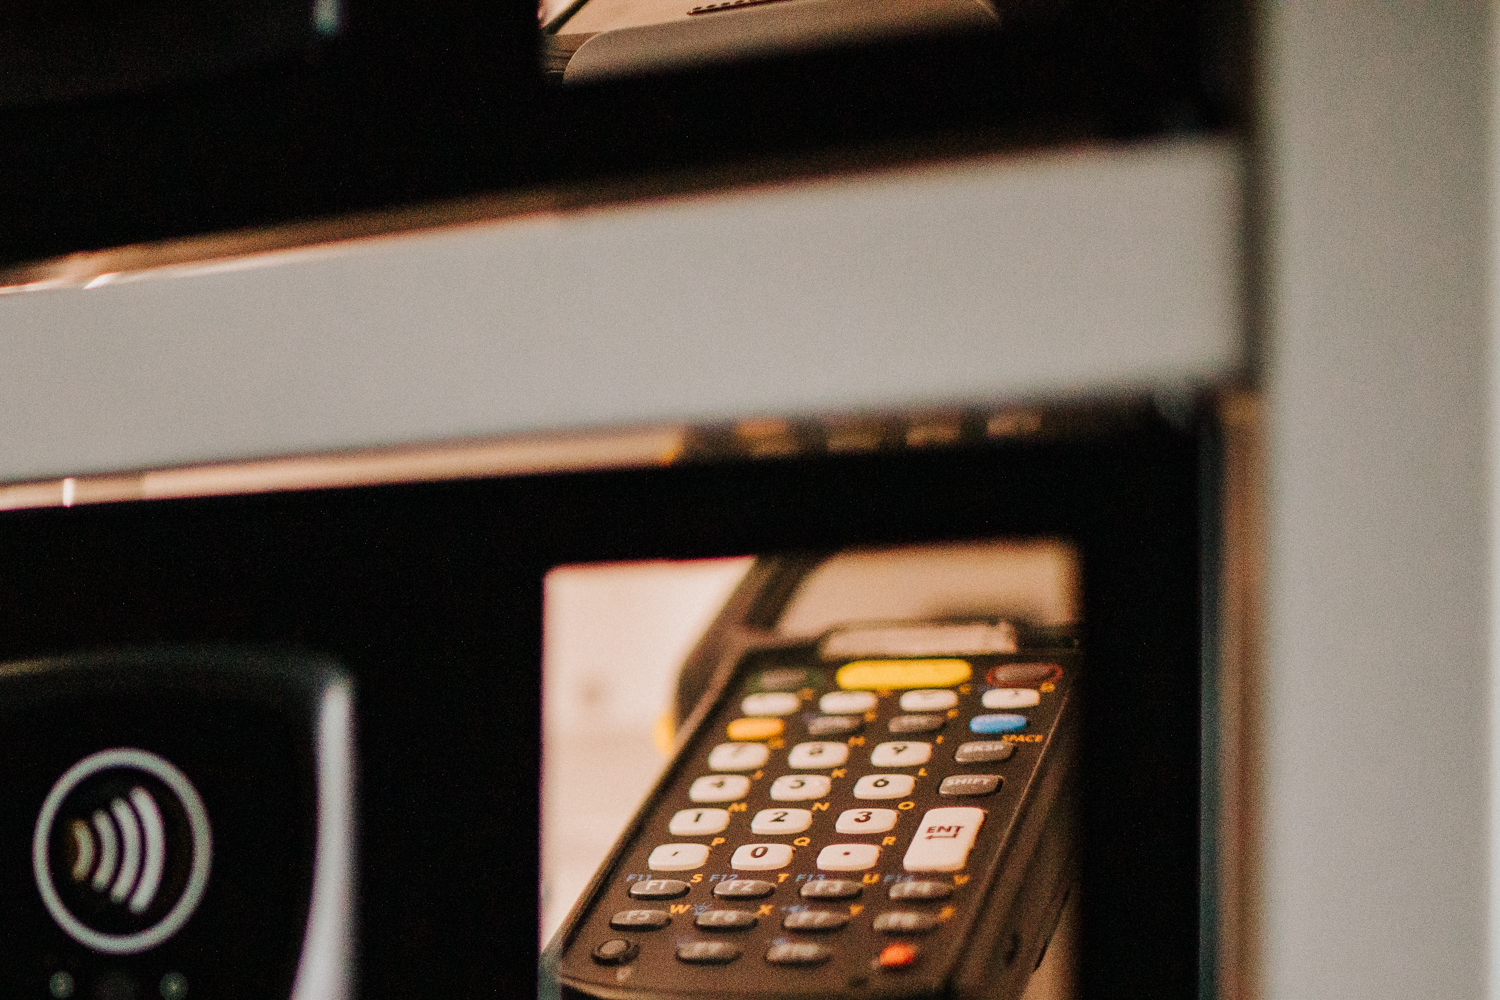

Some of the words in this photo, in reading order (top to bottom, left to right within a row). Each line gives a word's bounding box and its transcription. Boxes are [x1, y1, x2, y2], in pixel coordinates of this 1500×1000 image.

[1002, 734, 1043, 742] SPACE
[918, 768, 928, 777] L
[872, 778, 889, 789] 6
[946, 777, 993, 787] SHIFT
[728, 803, 747, 812] M
[812, 802, 830, 812] N
[693, 812, 703, 824] 1
[770, 811, 789, 823] 2
[854, 811, 873, 824] 3
[926, 825, 965, 834] ENT
[711, 837, 725, 847] P
[794, 837, 811, 847] Q
[882, 836, 897, 846] R
[626, 873, 652, 883] F11
[690, 873, 704, 883] S
[709, 873, 739, 883] F12
[778, 873, 789, 883] T
[862, 873, 881, 884] U
[645, 880, 670, 891] F1
[728, 880, 756, 892] F2
[670, 904, 691, 914] W
[757, 904, 774, 916] X
[626, 910, 650, 921] F5
